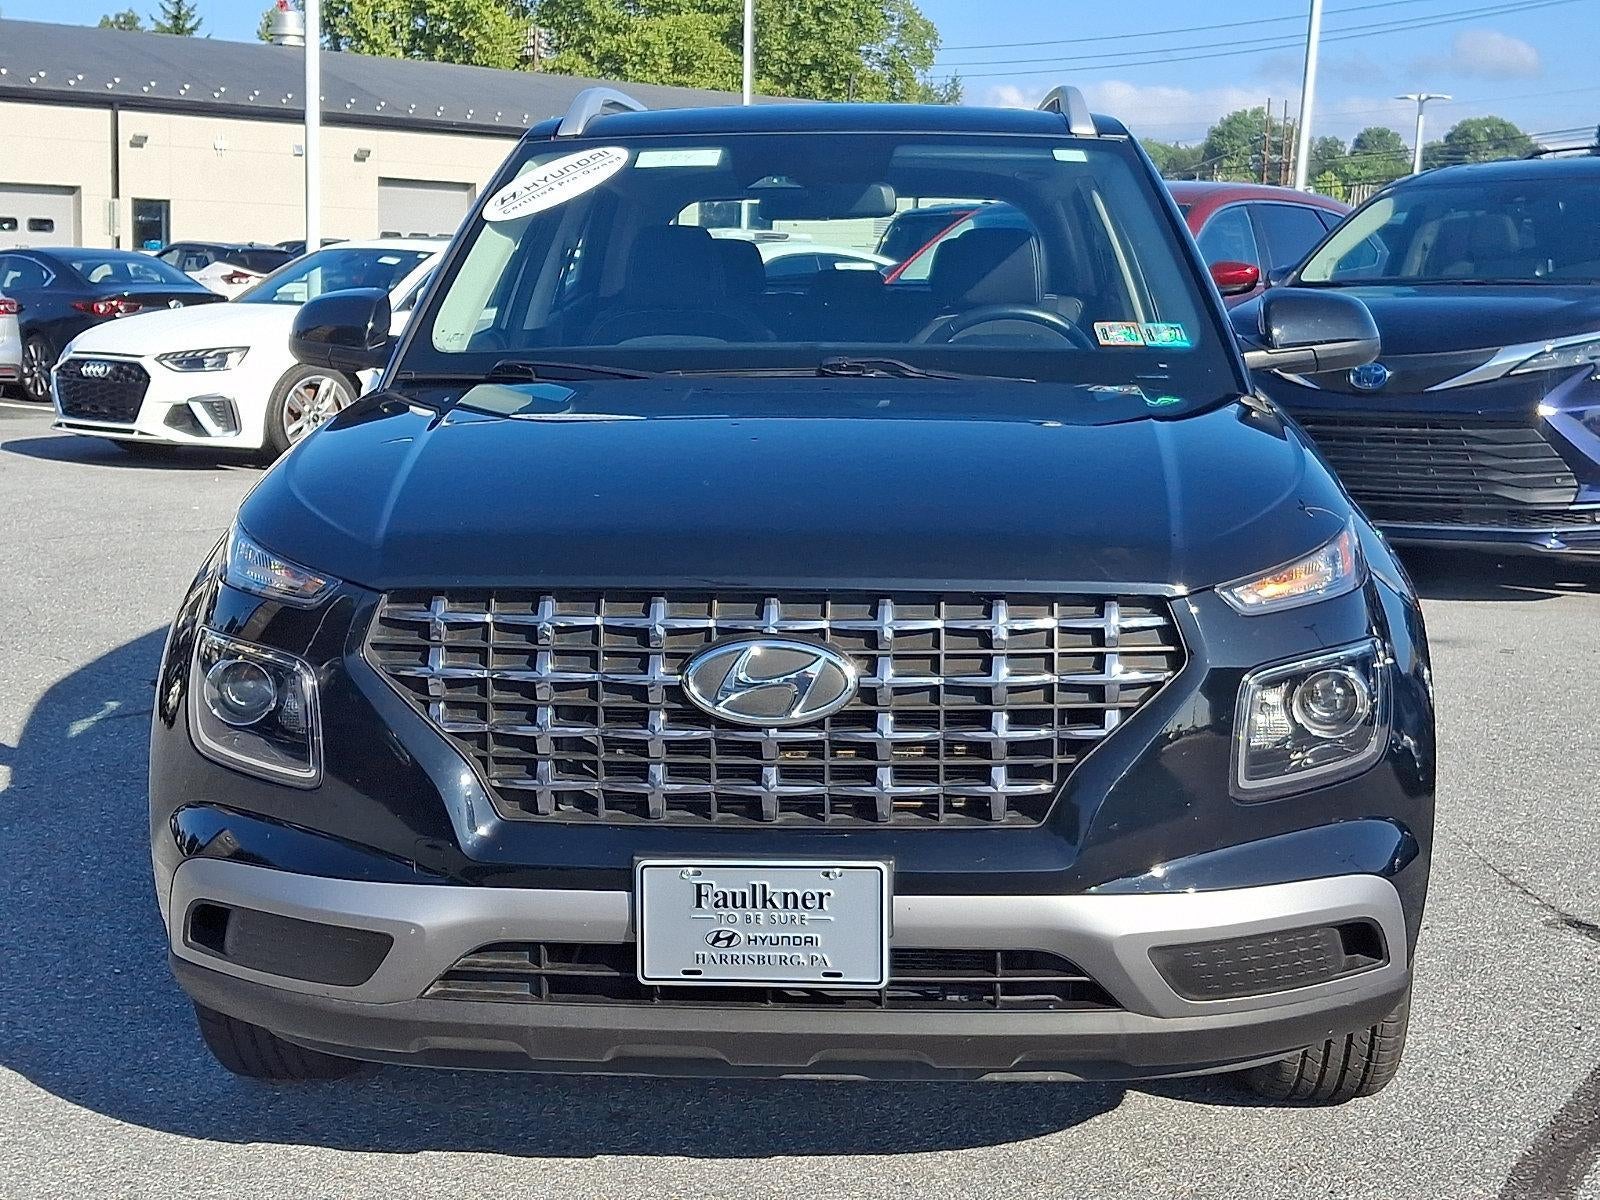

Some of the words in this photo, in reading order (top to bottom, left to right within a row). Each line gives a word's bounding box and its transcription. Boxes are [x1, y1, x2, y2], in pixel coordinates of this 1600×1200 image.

[523, 150, 610, 191] HYUNDAI
[502, 186, 554, 214] Certified
[1100, 327, 1110, 341] 8
[1146, 328, 1155, 342] 8
[691, 882, 832, 910] Faulkner
[717, 913, 738, 925] TO
[745, 914, 762, 925] BE
[770, 914, 807, 926] SURE
[747, 934, 819, 947] HYUNDAI
[695, 953, 806, 967] HARRISBURG,
[810, 954, 830, 967] PA
